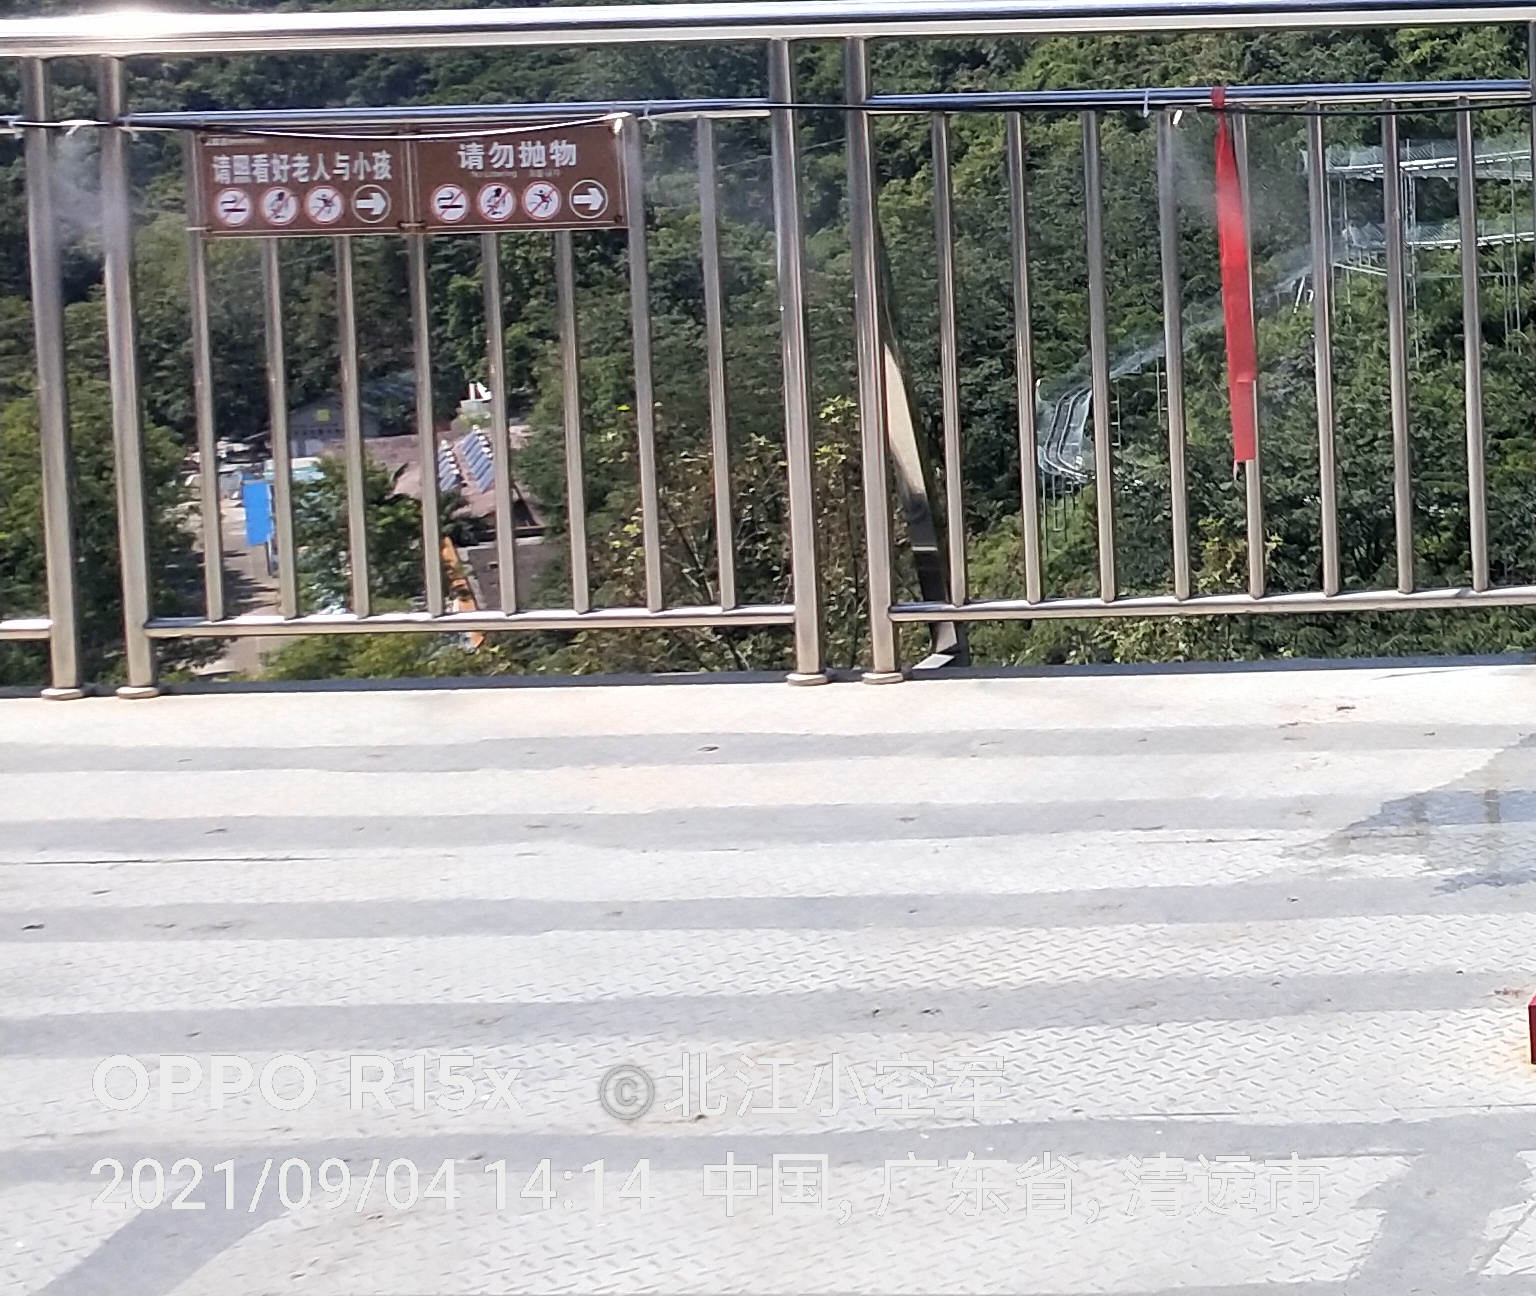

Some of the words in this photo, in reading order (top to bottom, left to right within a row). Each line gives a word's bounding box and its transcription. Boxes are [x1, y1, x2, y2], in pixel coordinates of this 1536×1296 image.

[212, 150, 392, 184] 请照看好老人与小孩
[457, 139, 577, 169] 请勿抛物
